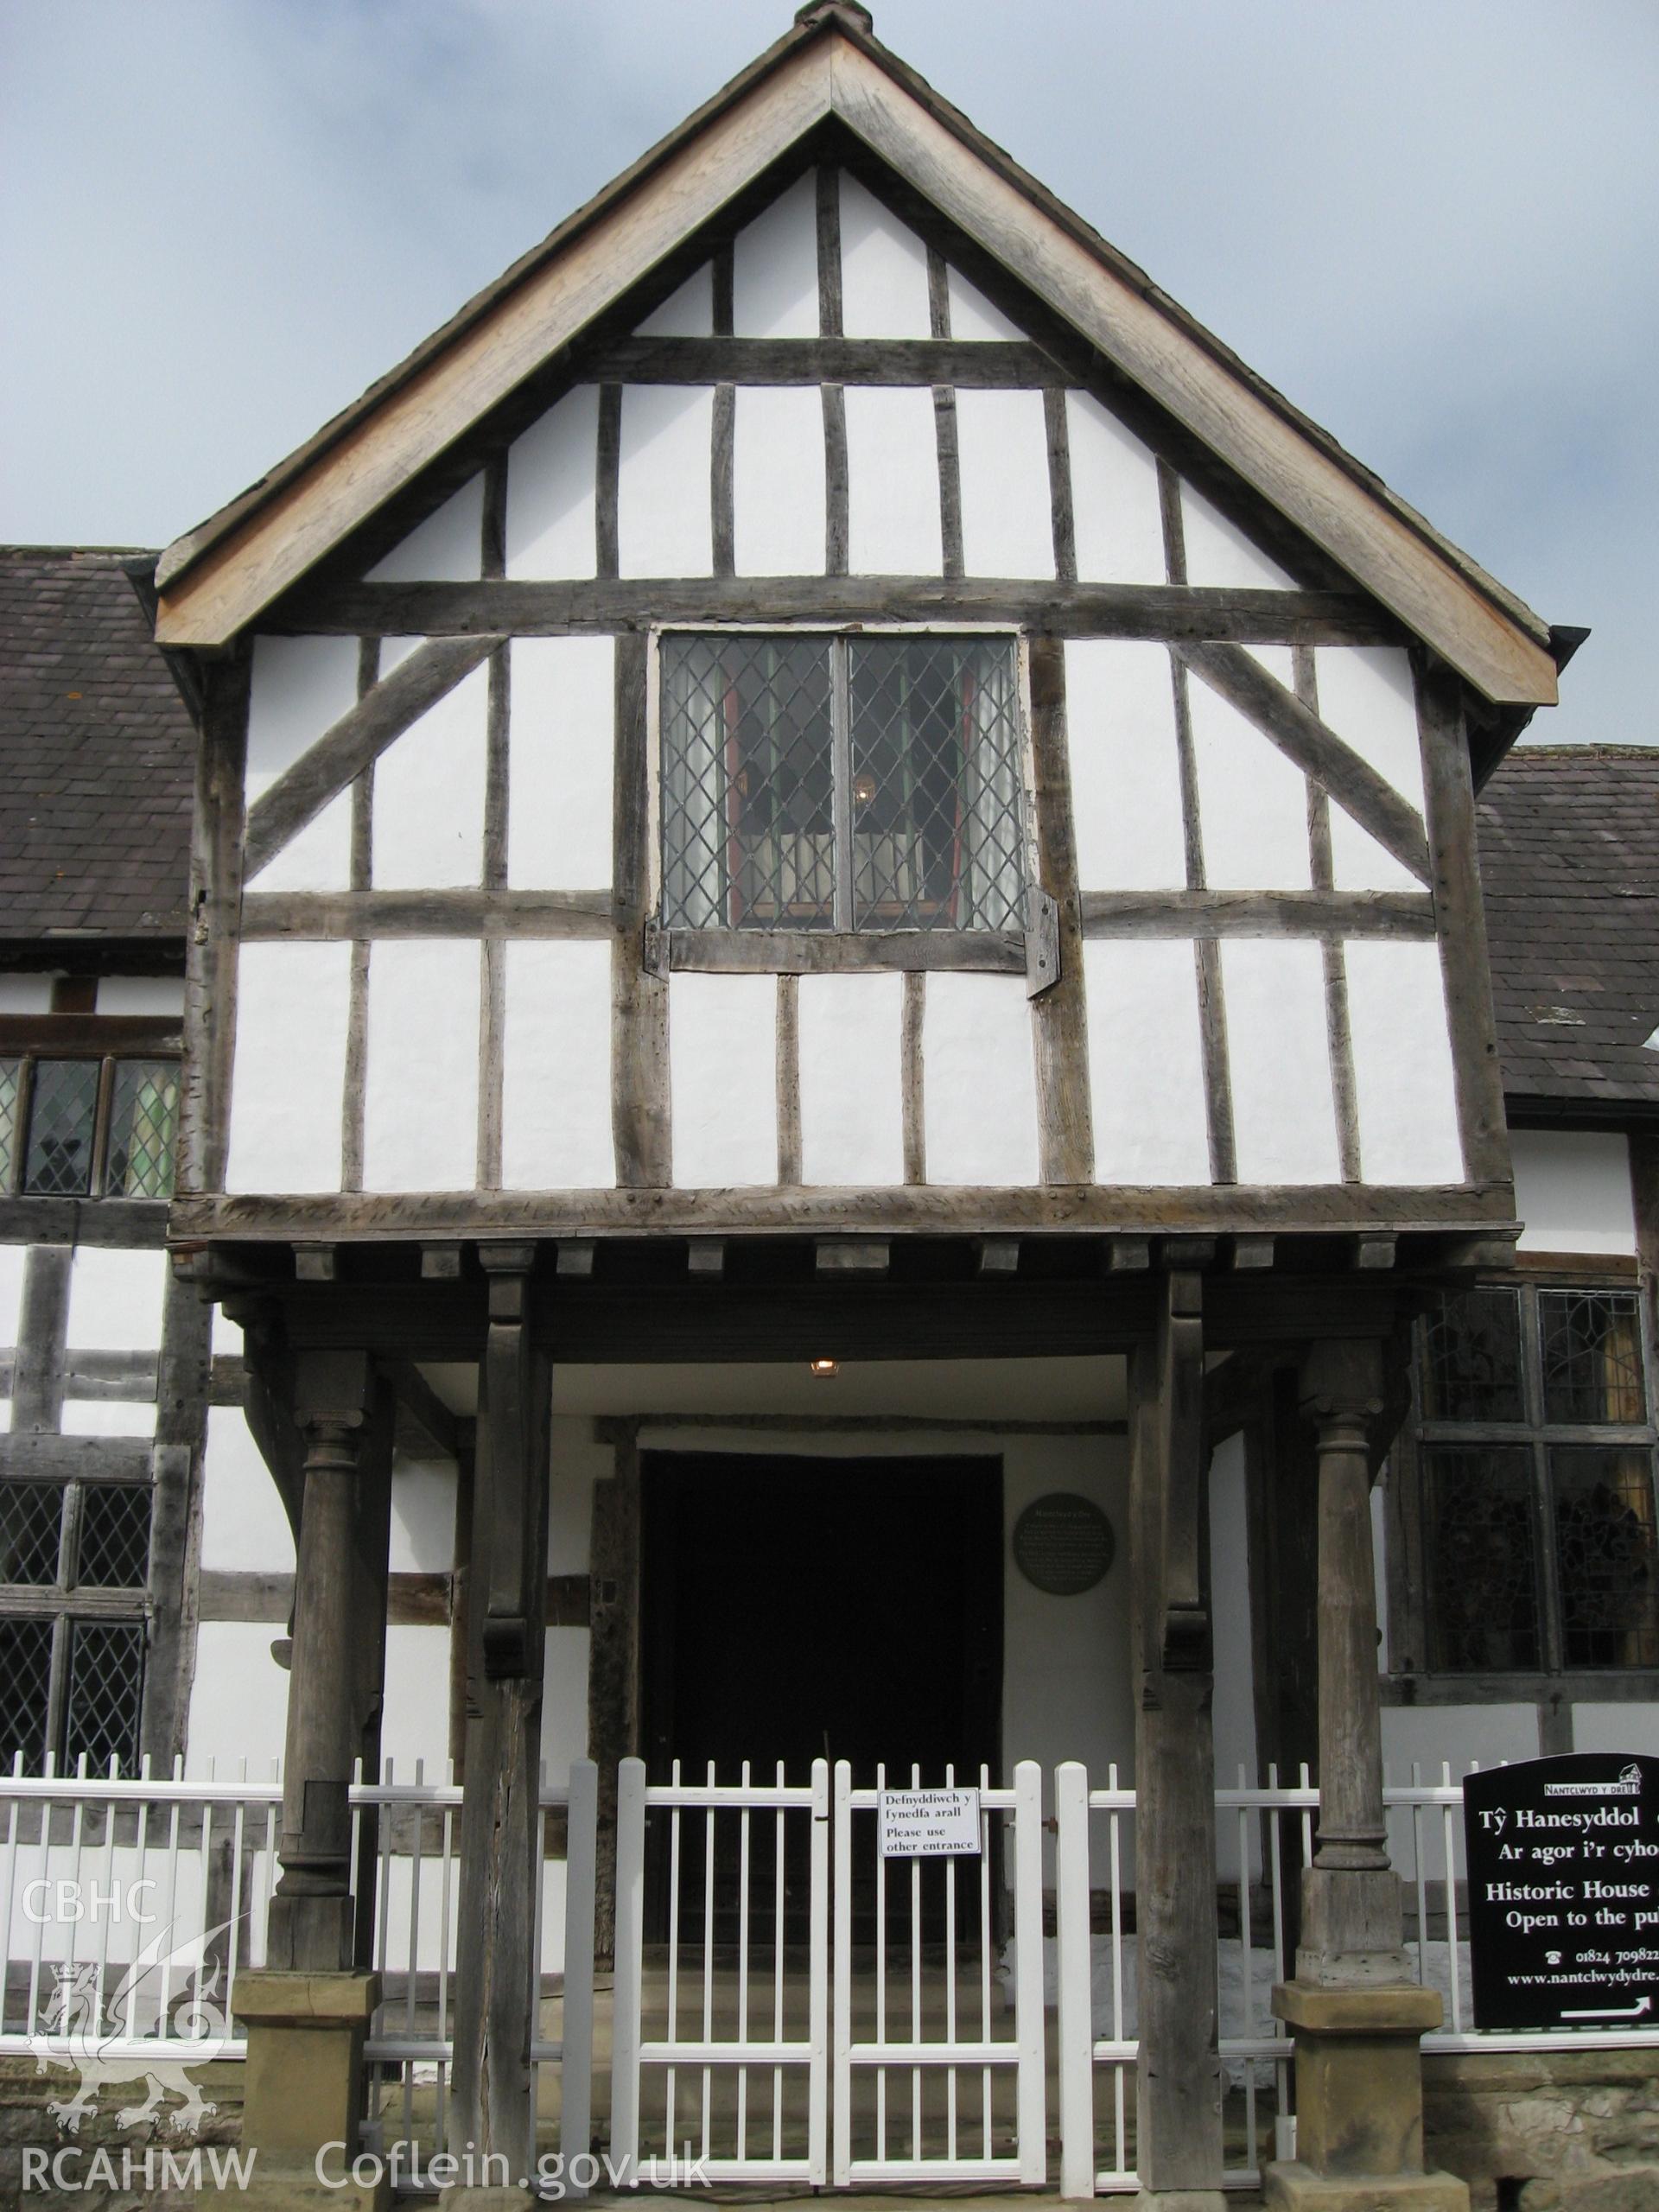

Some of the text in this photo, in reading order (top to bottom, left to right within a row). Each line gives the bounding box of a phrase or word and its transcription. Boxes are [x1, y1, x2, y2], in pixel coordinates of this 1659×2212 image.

[886, 1793, 970, 1808] Defnyddiwch y
[886, 1807, 961, 1822] fynedfa arall
[1478, 1806, 1640, 1835] Tŷ Hanesyddol
[887, 1827, 945, 1838] Please use
[887, 1841, 974, 1852] other entrance
[1498, 1844, 1523, 1859] Ar
[1531, 1847, 1574, 1866] agor
[1613, 1839, 1659, 1862] cyho
[1485, 1880, 1649, 1902] Historic House
[1506, 1907, 1659, 1934] Open to the pu
[1576, 1947, 1659, 1964] 01824 709822
